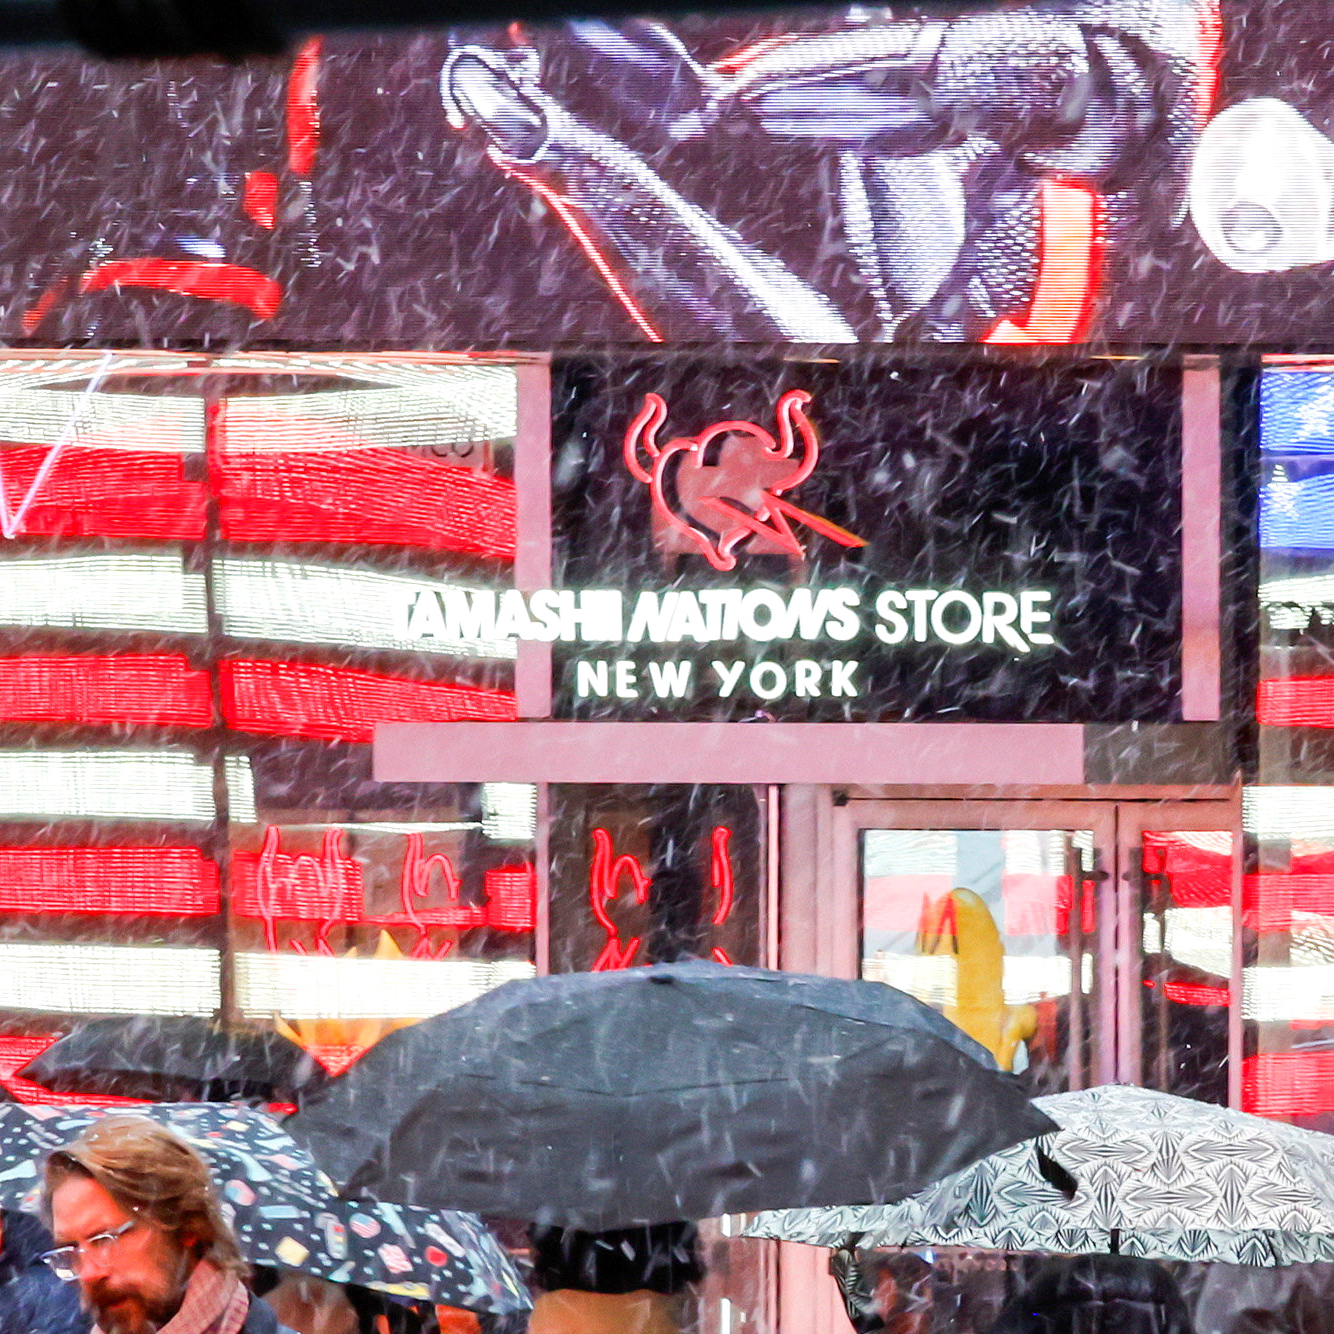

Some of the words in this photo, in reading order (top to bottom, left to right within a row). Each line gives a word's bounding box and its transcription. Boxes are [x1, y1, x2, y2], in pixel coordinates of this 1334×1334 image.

[626, 588, 861, 643] NATIONS
[874, 589, 1055, 653] STORE
[576, 659, 692, 699] NEW
[712, 659, 859, 700] YORK
